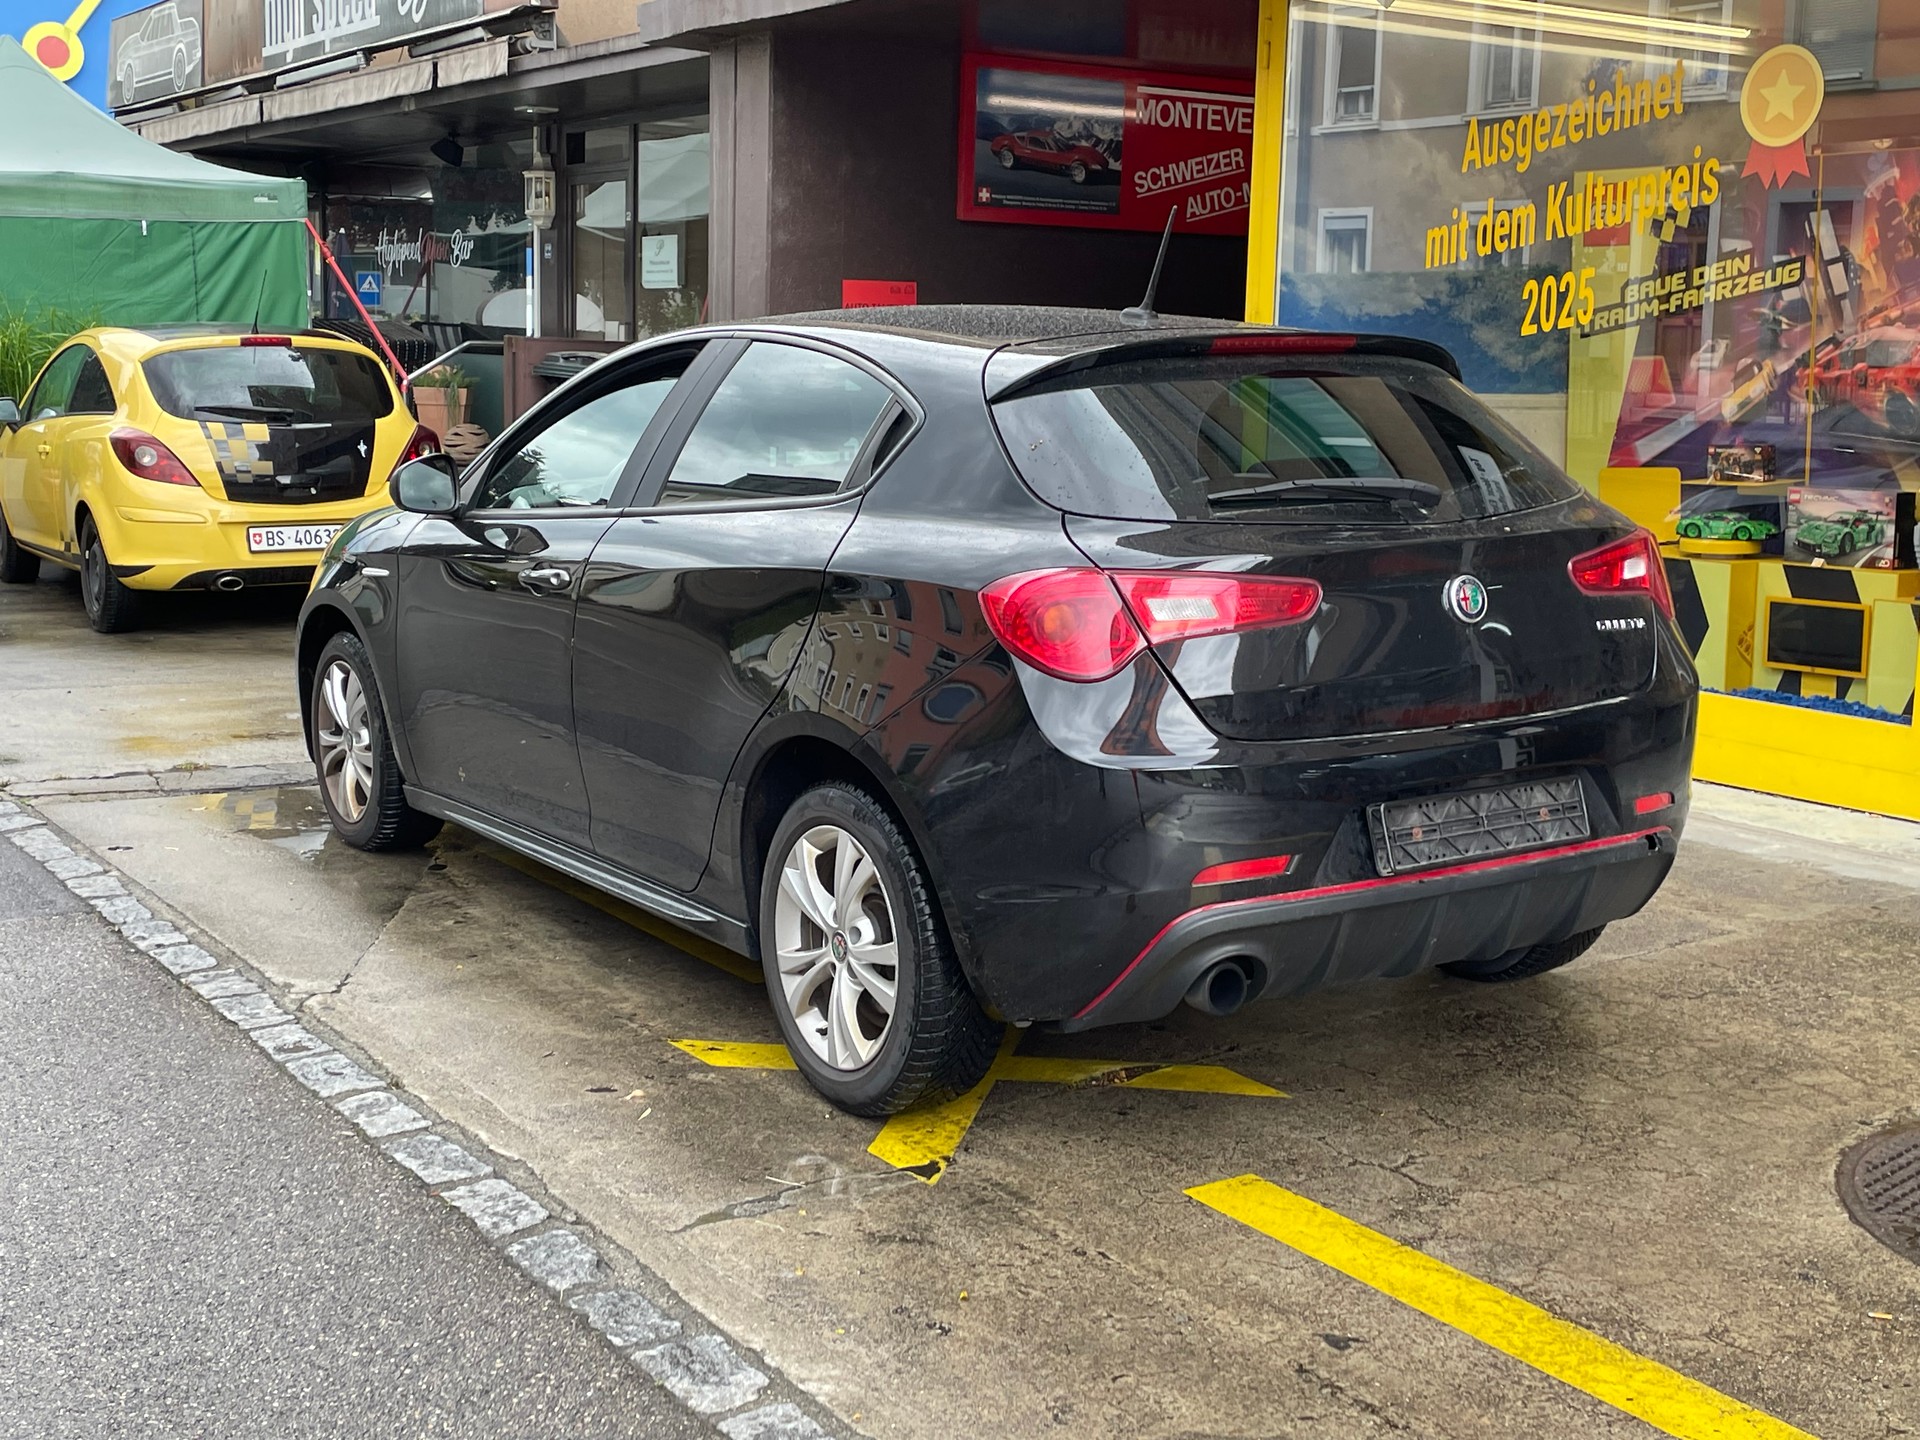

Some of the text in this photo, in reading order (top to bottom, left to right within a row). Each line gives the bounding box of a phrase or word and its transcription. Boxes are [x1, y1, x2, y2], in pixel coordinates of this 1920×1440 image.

[1136, 99, 1252, 134] MONTEVE
[1461, 58, 1686, 173] Ausgezeichnet
[1134, 148, 1245, 194] SCHWEIZER
[1425, 207, 1468, 269] mit
[1476, 197, 1536, 258] dem
[1545, 145, 1720, 241] Kulturpreis
[375, 228, 423, 277] Highspeed
[450, 228, 474, 268] Bar
[1521, 266, 1596, 337] 2025
[1624, 253, 1751, 303] BAUE DEIN
